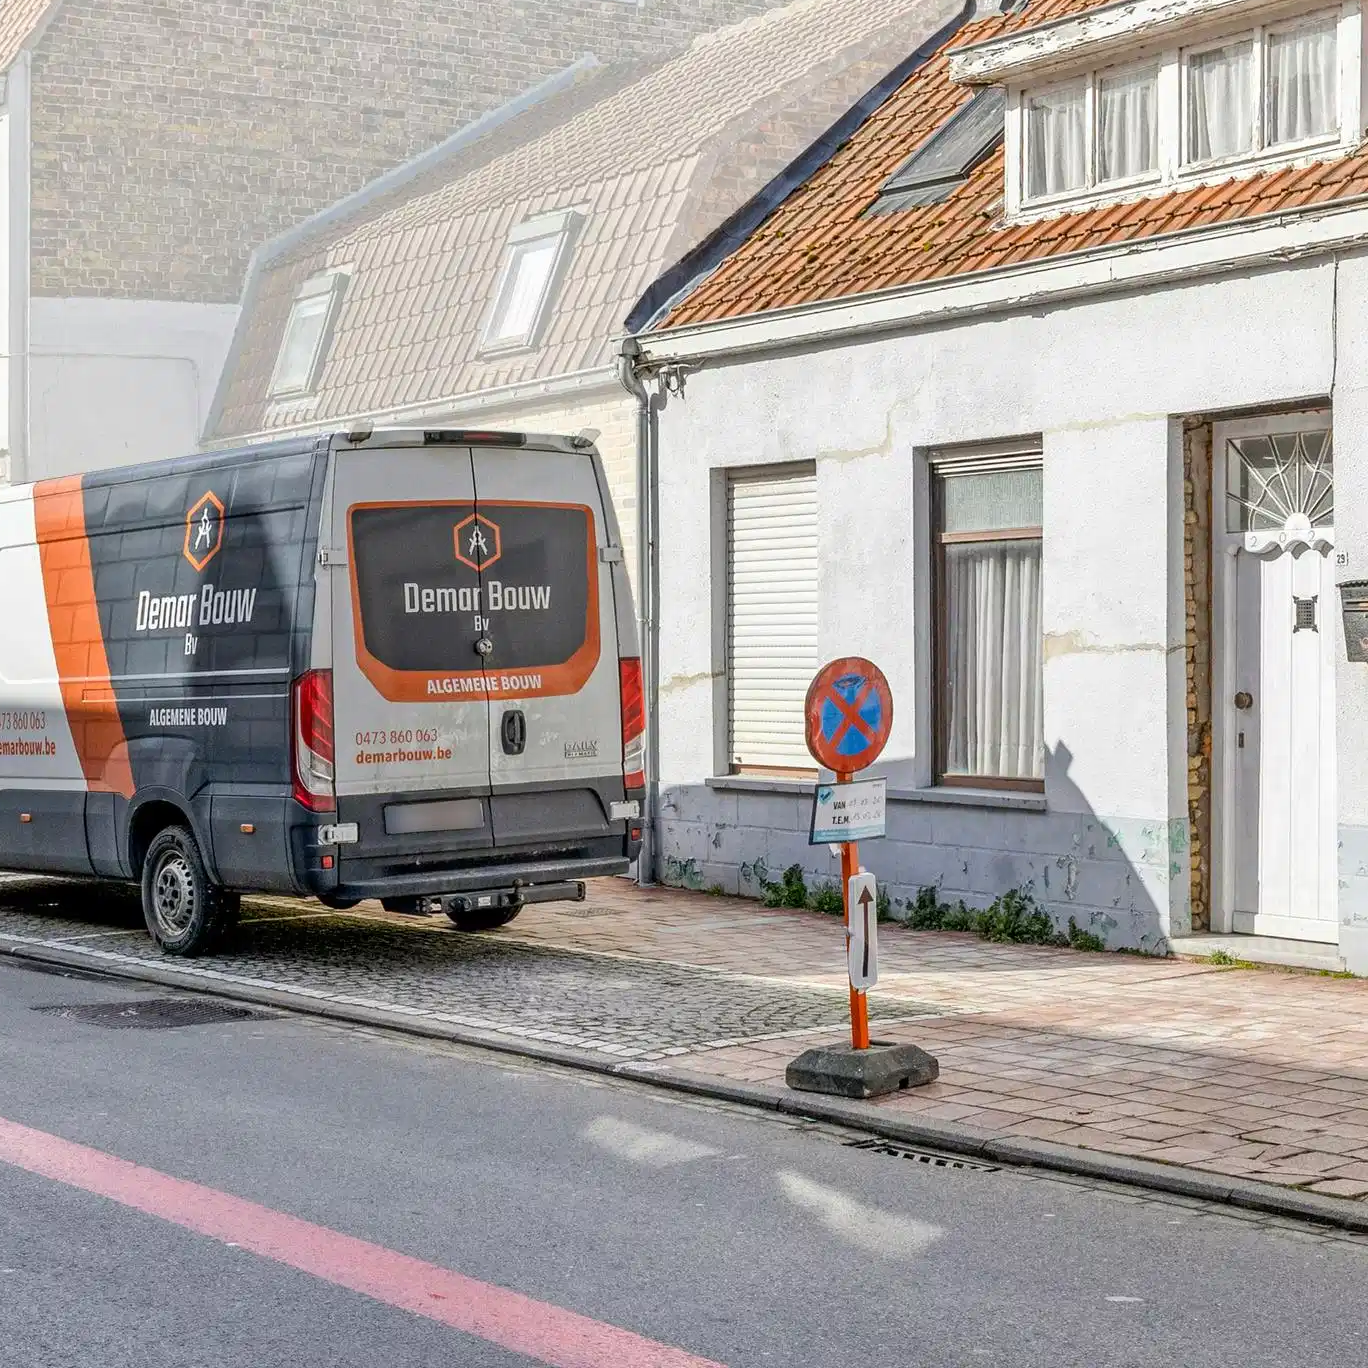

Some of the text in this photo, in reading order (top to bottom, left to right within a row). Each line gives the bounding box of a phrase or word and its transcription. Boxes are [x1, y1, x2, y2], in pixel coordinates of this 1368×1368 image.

[1336, 553, 1346, 564] 29
[404, 580, 551, 614] Demar Bouw
[136, 584, 256, 631] Demar Bouw
[474, 615, 490, 632] Bv
[184, 633, 198, 655] Bv
[427, 674, 542, 694] ALGEMENE BOUW
[13, 711, 29, 730] 860
[30, 711, 47, 729] 063
[149, 707, 228, 726] ALGEMENE BOUW
[355, 728, 438, 746] 0473 860 063
[356, 746, 453, 765] demarbouw.be
[833, 800, 846, 810] VAN
